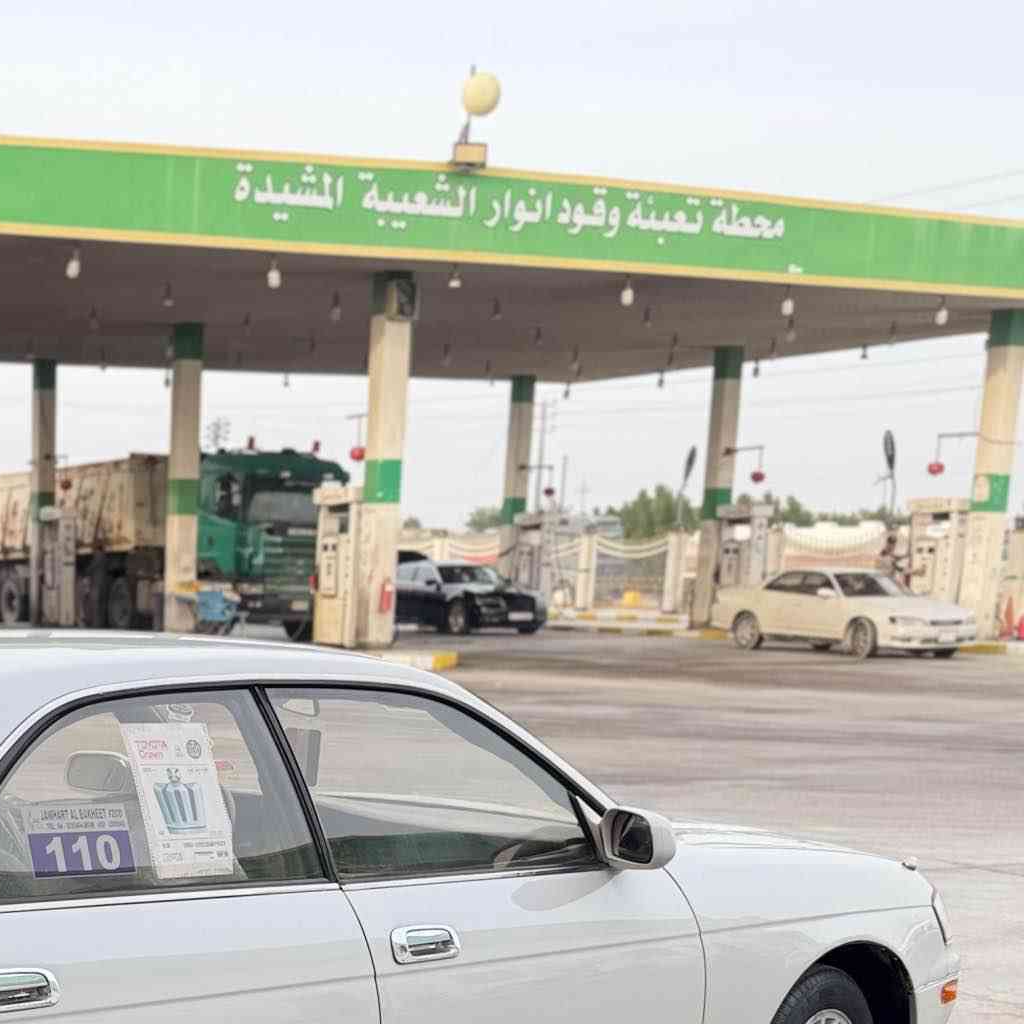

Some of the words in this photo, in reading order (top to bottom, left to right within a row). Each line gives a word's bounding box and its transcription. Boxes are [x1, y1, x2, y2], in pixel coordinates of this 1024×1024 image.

[234, 163, 344, 222] المشيدة
[357, 172, 477, 230] الشعيبة
[483, 187, 552, 232] انوار
[557, 186, 621, 239] وقود
[626, 191, 704, 245] تعبئة
[710, 197, 785, 239] محطة
[134, 740, 168, 751] TOYOTA
[45, 834, 121, 873] 110
